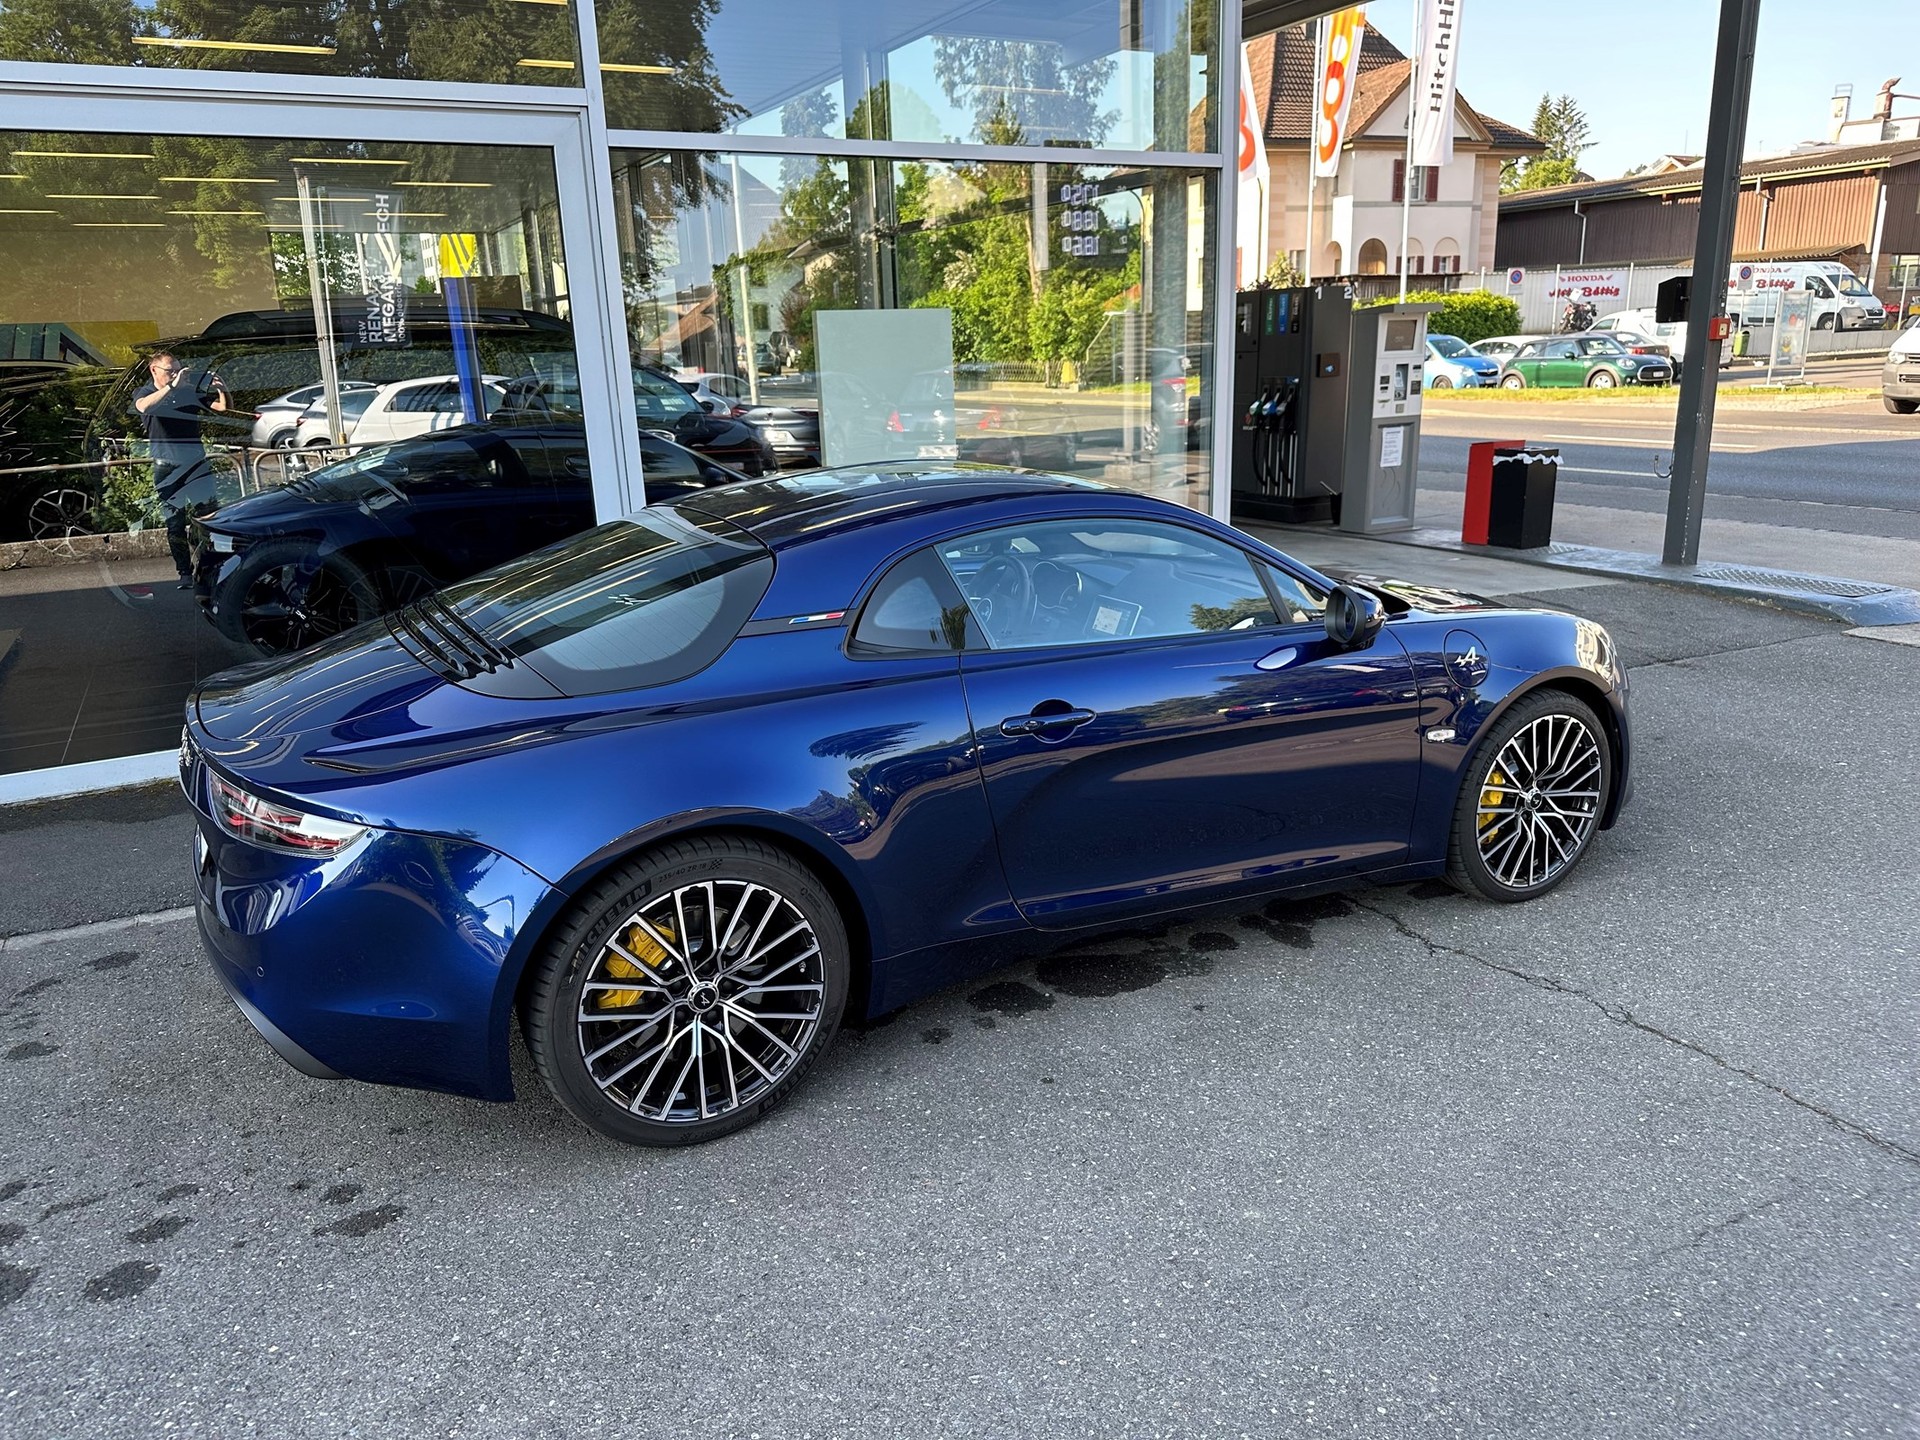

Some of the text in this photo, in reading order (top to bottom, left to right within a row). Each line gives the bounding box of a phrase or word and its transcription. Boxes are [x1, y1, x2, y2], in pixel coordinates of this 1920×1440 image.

[1314, 286, 1323, 300] 1
[1343, 286, 1352, 300] 2
[358, 320, 367, 343] NEW
[1241, 319, 1247, 333] 1
[570, 883, 650, 969] MICHELIN
